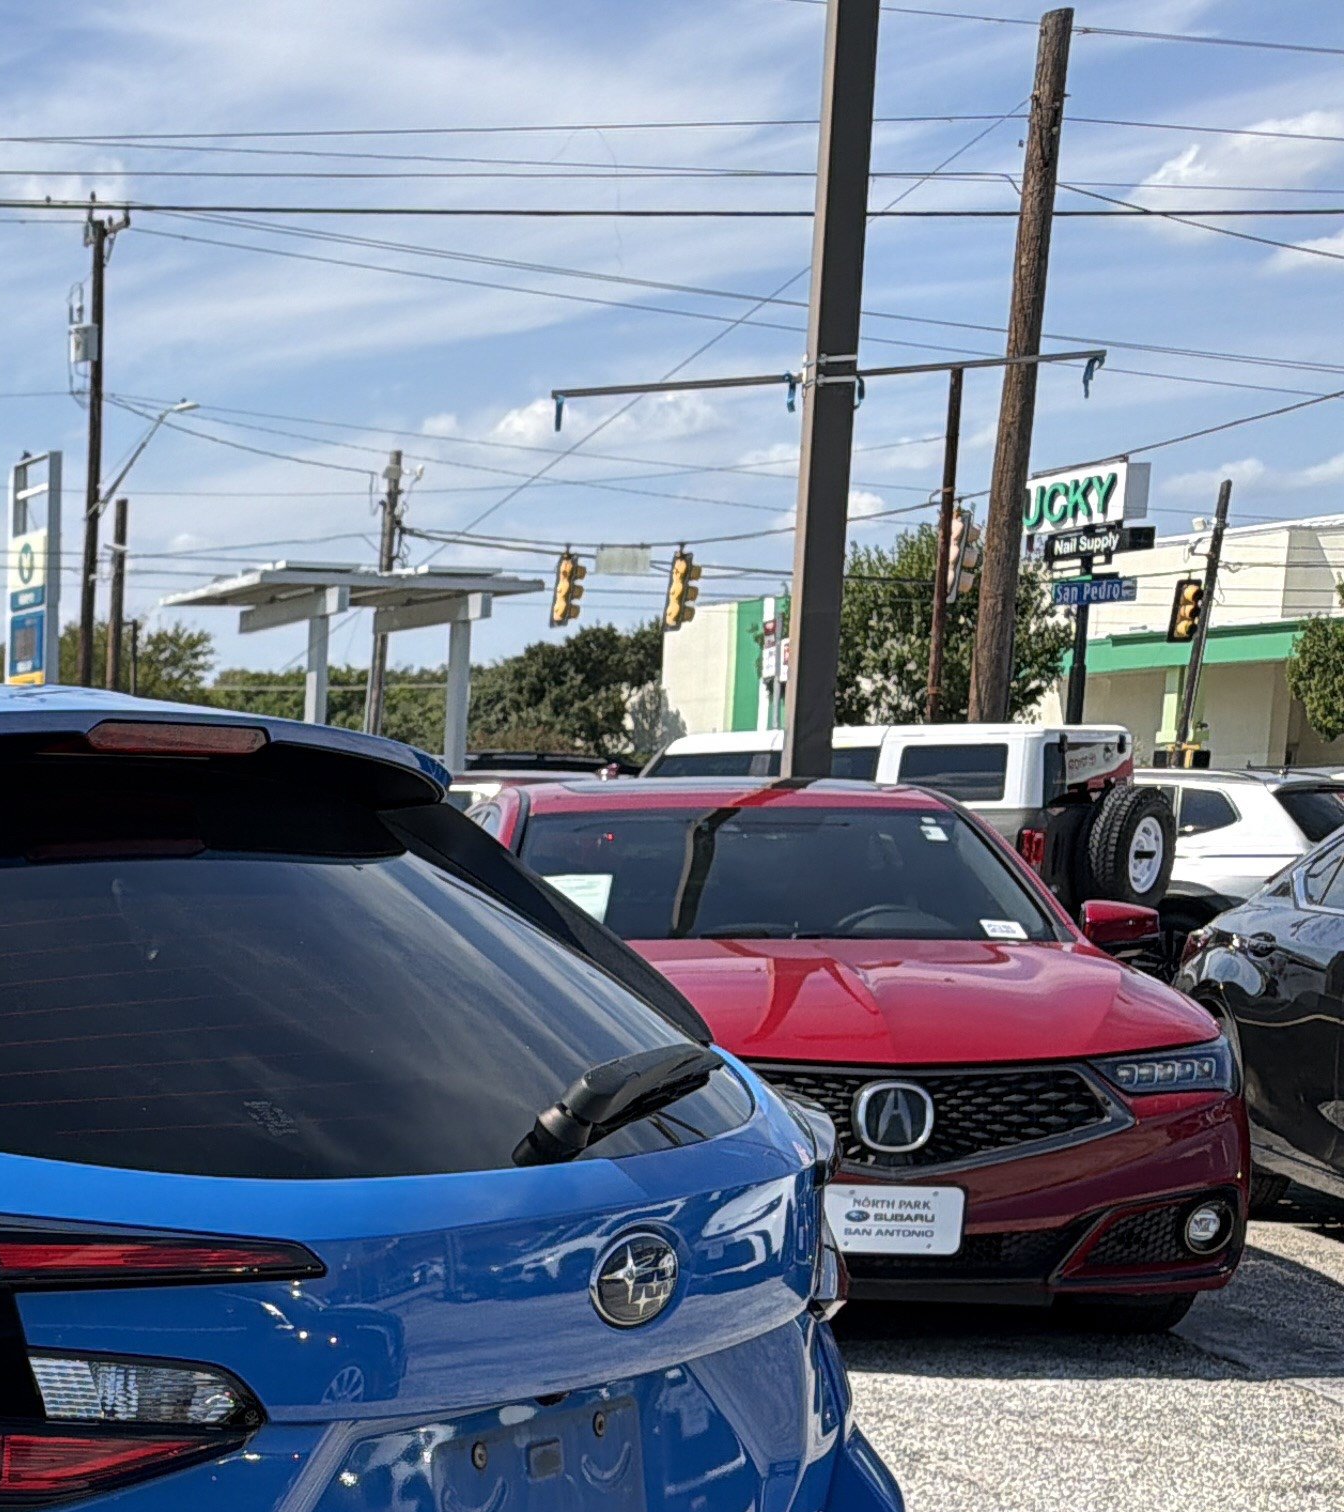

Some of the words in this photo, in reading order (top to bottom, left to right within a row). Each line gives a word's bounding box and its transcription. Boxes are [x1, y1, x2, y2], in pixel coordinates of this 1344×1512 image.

[1022, 472, 1119, 529] UCKY
[1054, 535, 1078, 556] Nail
[1078, 531, 1121, 554] Supply
[1056, 582, 1079, 603] San
[1083, 578, 1121, 600] Pedro
[852, 1197, 895, 1210] NORTH
[898, 1199, 931, 1211] PARK
[873, 1213, 936, 1223] SUBARU
[844, 1227, 872, 1237] SAN
[874, 1228, 935, 1238] ANTONIO
